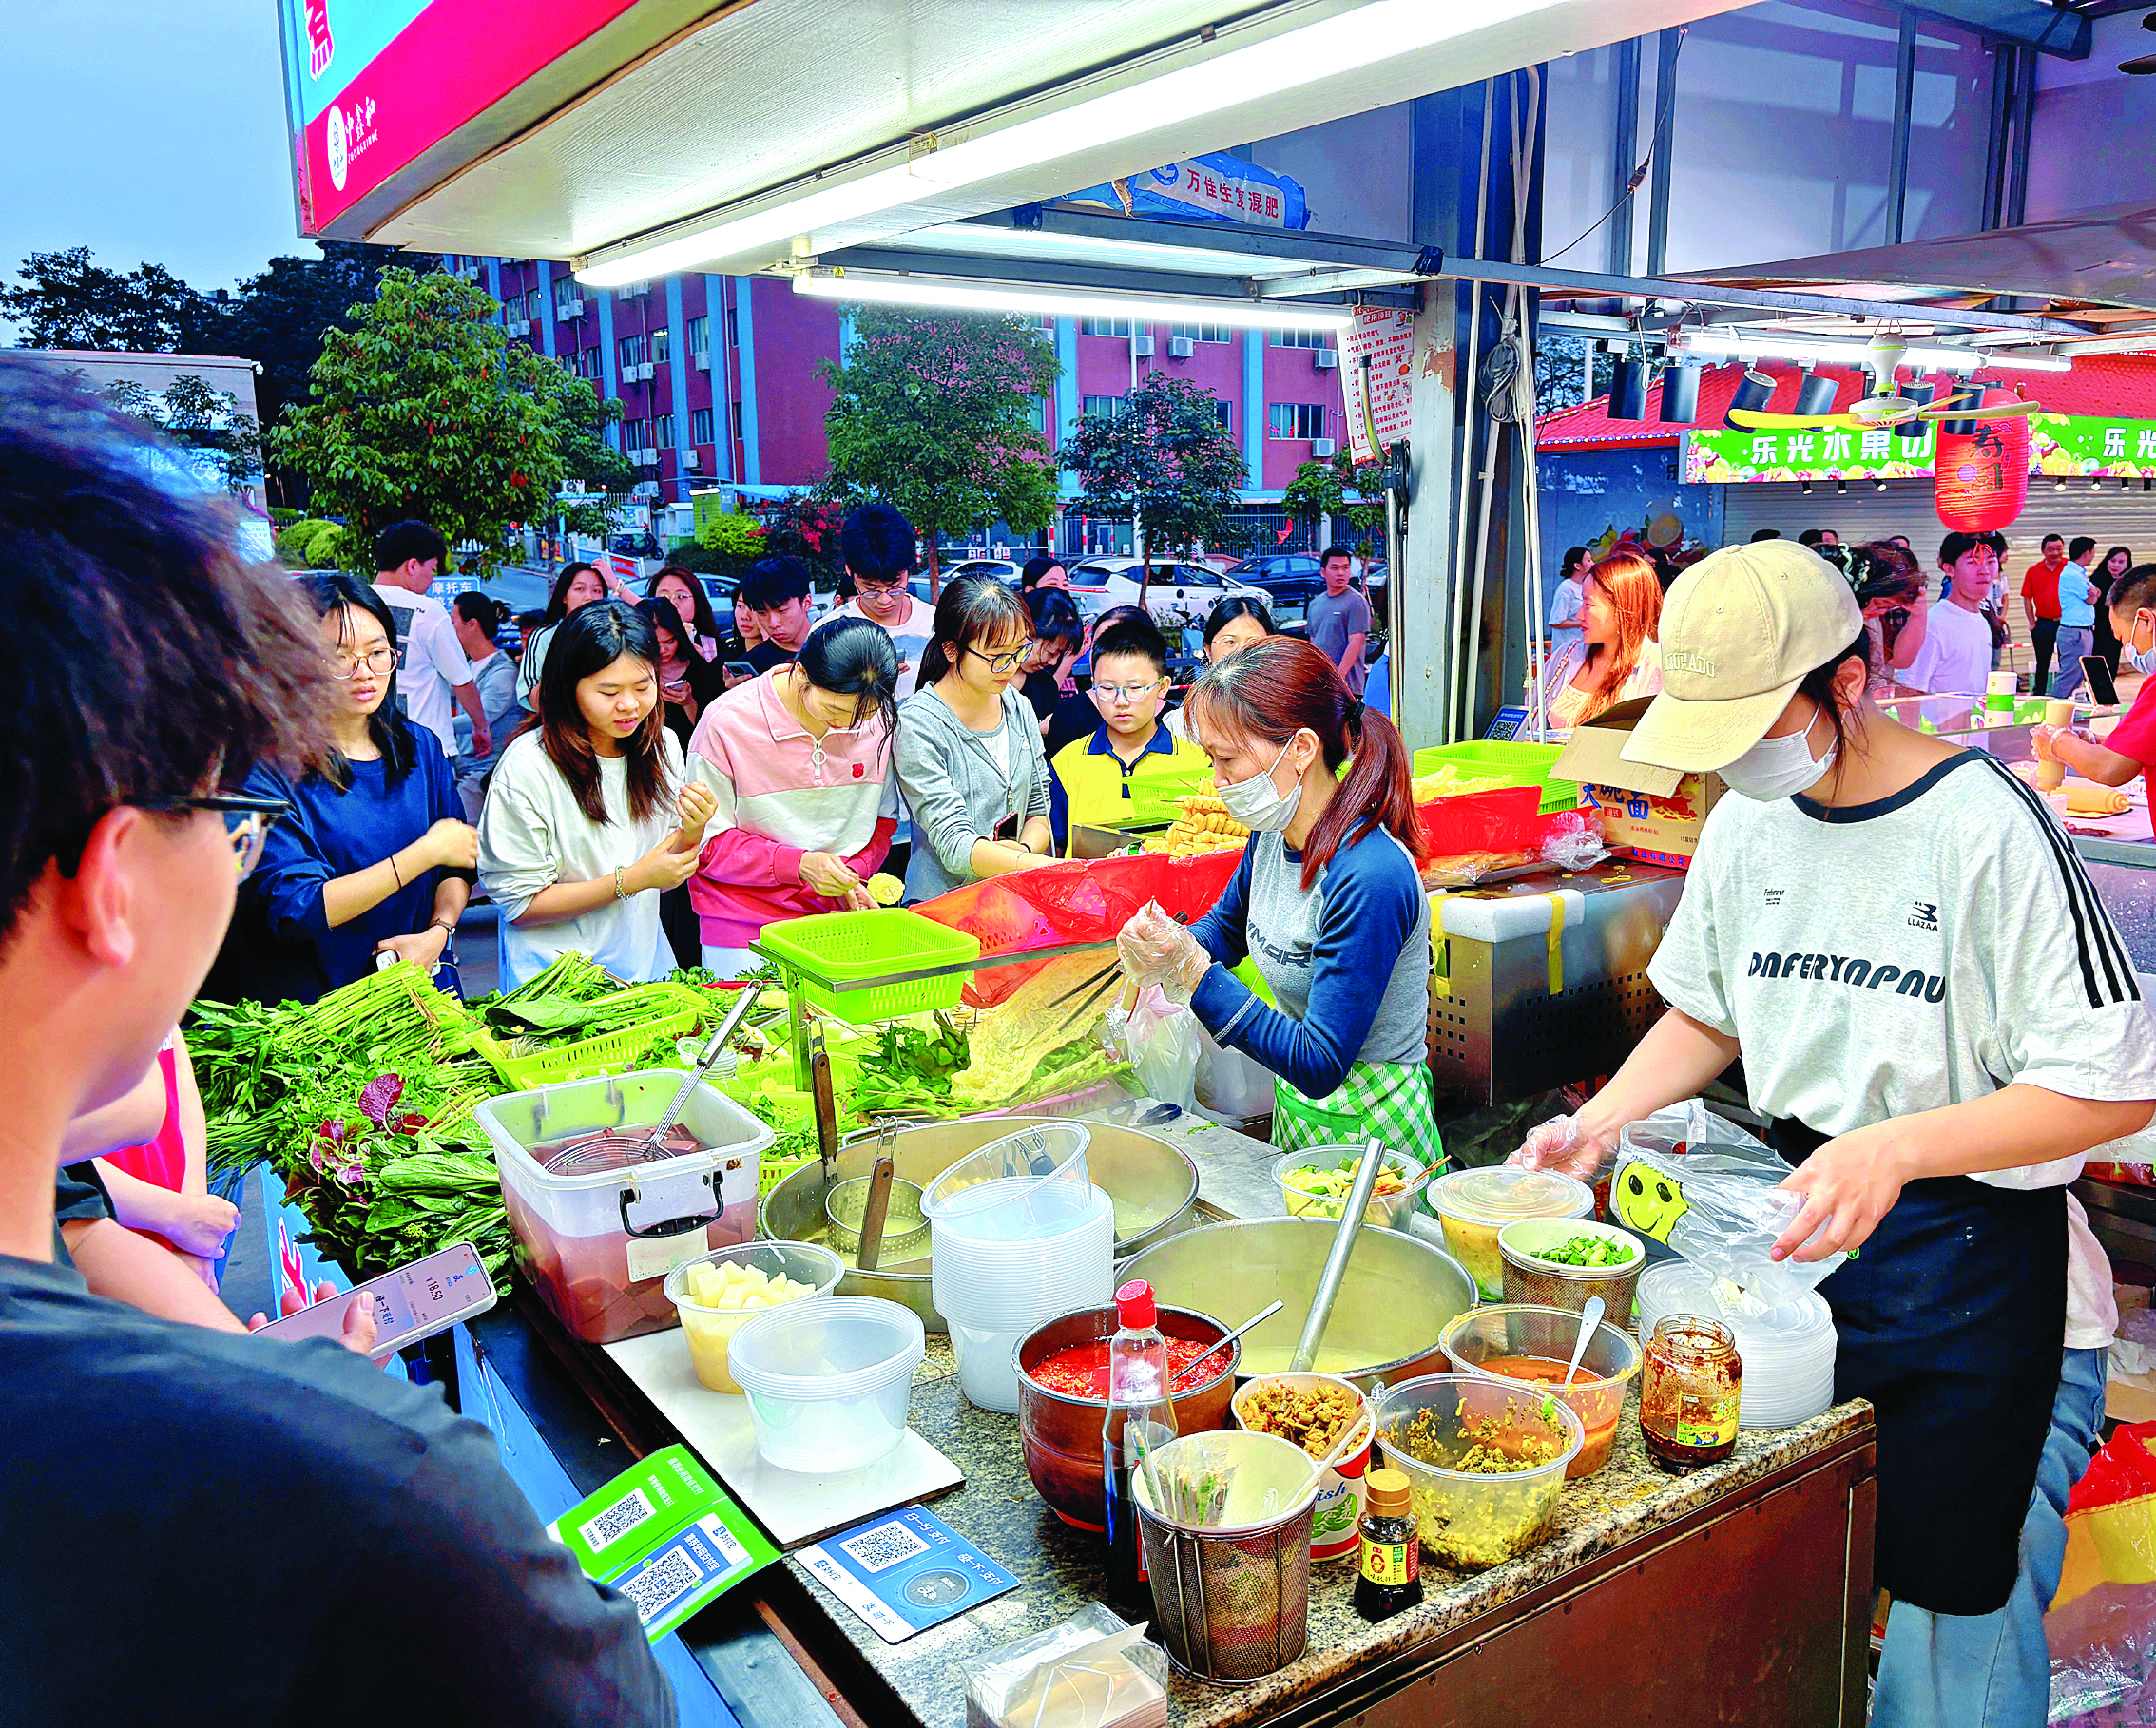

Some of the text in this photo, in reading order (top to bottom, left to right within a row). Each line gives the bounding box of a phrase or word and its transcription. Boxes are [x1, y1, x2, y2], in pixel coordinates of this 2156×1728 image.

[1187, 168, 1279, 219] 万佳生复混肥
[433, 582, 472, 594] 摩托车
